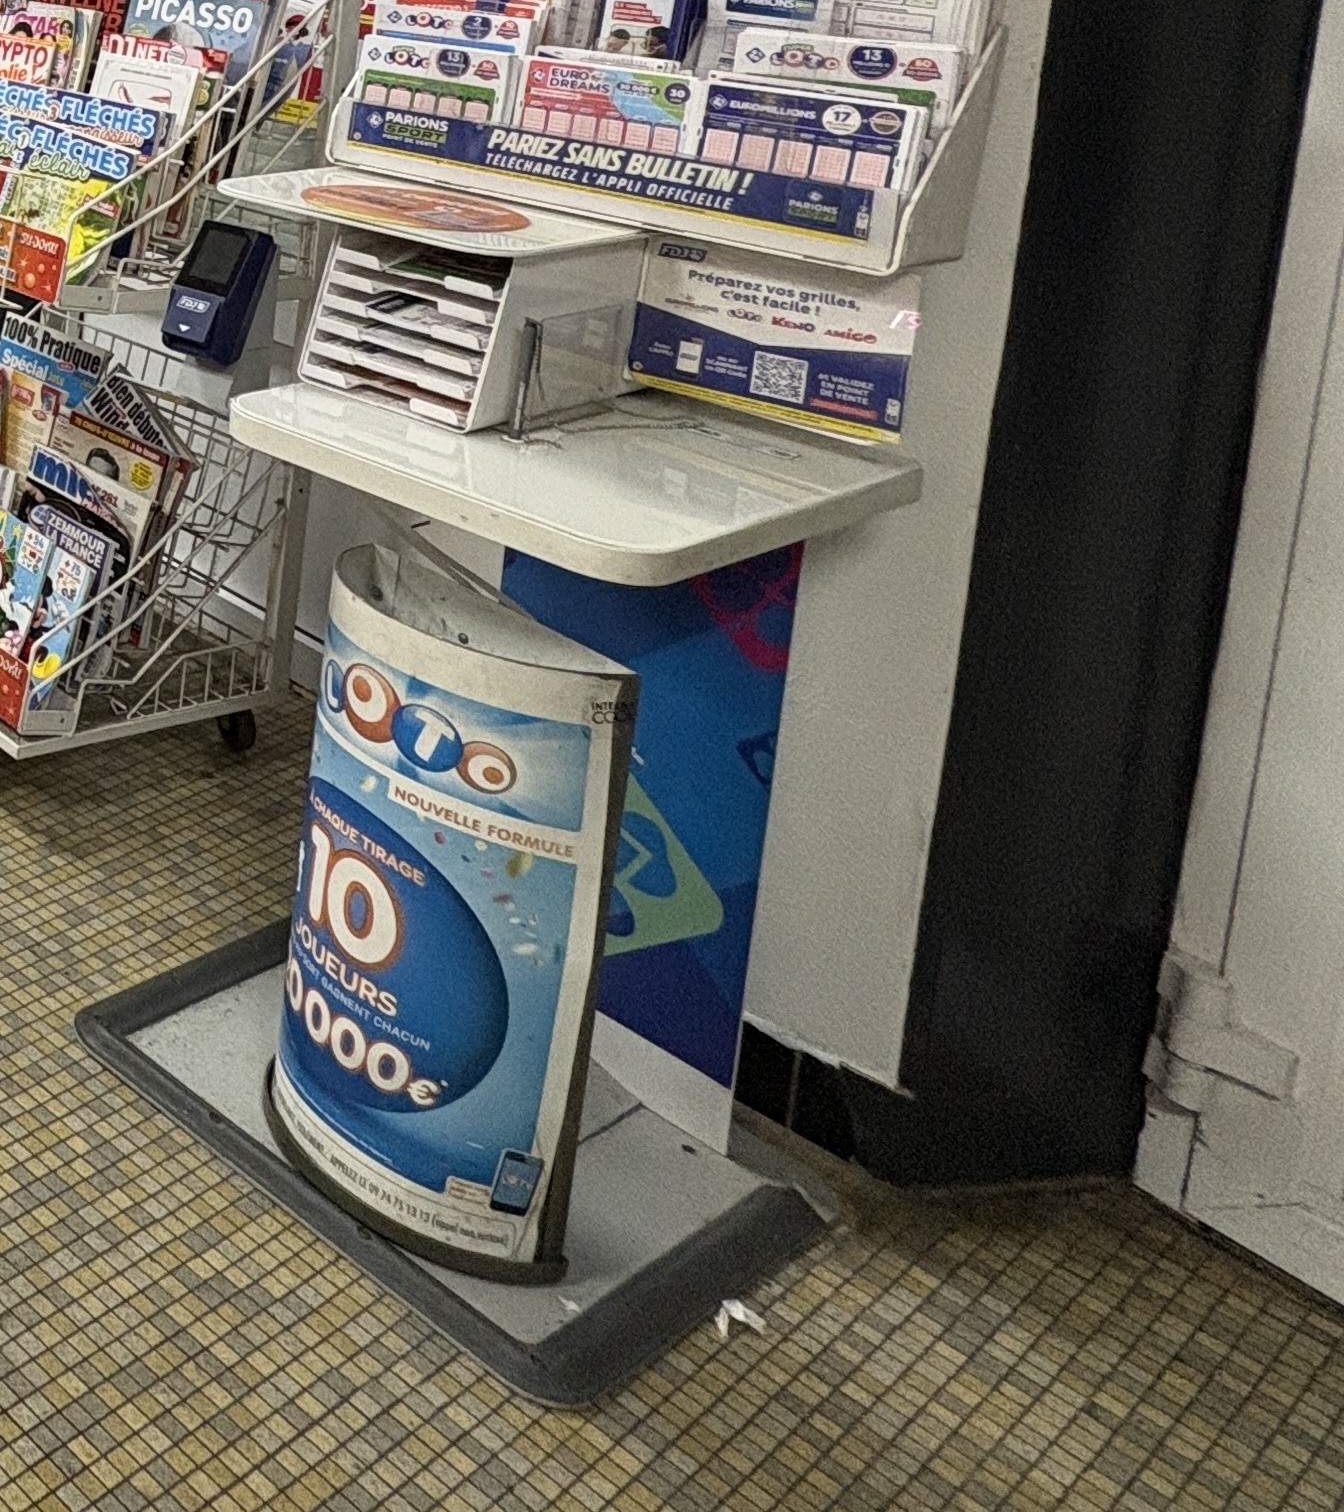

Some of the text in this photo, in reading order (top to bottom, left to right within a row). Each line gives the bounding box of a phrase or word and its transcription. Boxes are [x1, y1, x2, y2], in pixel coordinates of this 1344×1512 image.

[406, 11, 455, 30] LOTO
[770, 50, 840, 70] LOTO
[862, 49, 883, 62] 13
[550, 77, 610, 94] DREAMS
[552, 68, 589, 79] EURO
[669, 88, 686, 98] 30
[61, 97, 155, 138] FLÉCHÉS
[386, 112, 449, 131] PARIONS
[729, 100, 817, 120] EUROMILLIONS
[833, 110, 851, 122] 17
[386, 125, 444, 142] SPORT
[28, 150, 90, 182] éclair
[32, 126, 130, 179] FLÉCHÉS
[487, 129, 564, 162] PARIEZ
[563, 142, 625, 173] SANS
[625, 152, 739, 190] BULLETIN
[485, 152, 734, 211] TÉLÉCHARGEZ L'APPLI OFFICIELLE
[789, 199, 839, 215] PARIONS
[688, 269, 861, 312] Préparez vos grilles,
[720, 289, 759, 306] c'est
[762, 295, 811, 315] facile
[4, 317, 101, 376] 100% Pratique
[2, 348, 48, 381] Spécial
[820, 381, 834, 390] EN
[830, 374, 874, 390] VALIDEZ
[820, 389, 870, 405] DE VENTE
[45, 525, 104, 569] LA FRANCE
[47, 513, 106, 554] ZEMMOUR
[324, 659, 516, 794] LOTO
[395, 786, 575, 858] NOUVELLE FORMULE
[315, 794, 425, 887] CHAQUE TIRAGE
[310, 825, 401, 964] 10
[296, 917, 398, 1016] JOUEURS
[321, 976, 431, 1051] GAGNENT CHACUN
[330, 1156, 358, 1182] APPELEZ
